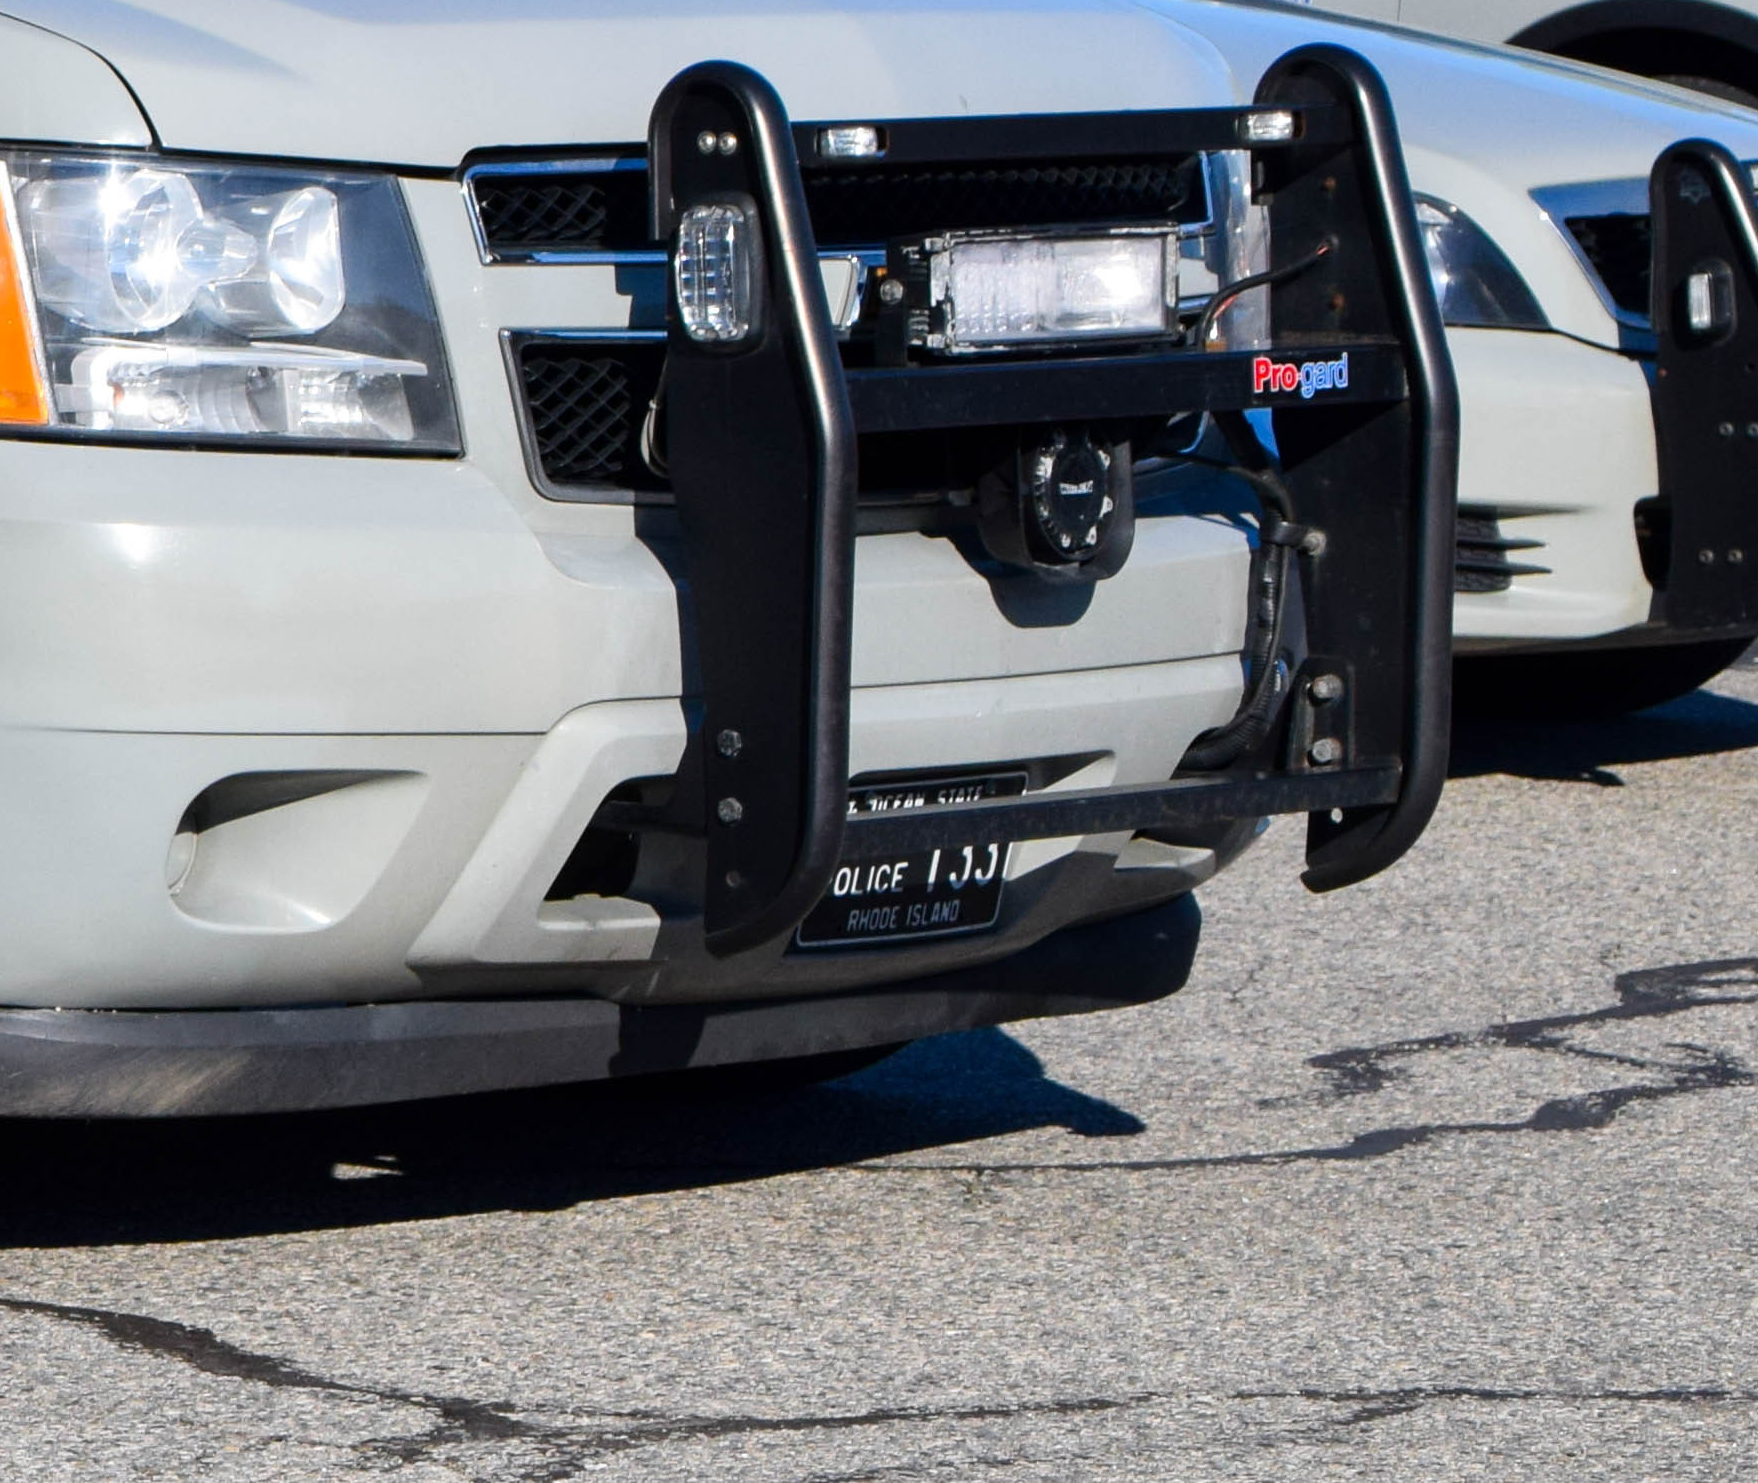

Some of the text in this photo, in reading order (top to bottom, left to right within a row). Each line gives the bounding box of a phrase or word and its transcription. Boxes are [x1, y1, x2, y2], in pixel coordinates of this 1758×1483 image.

[833, 861, 909, 897] OLICE
[846, 899, 961, 933] RHODE ISLAND
